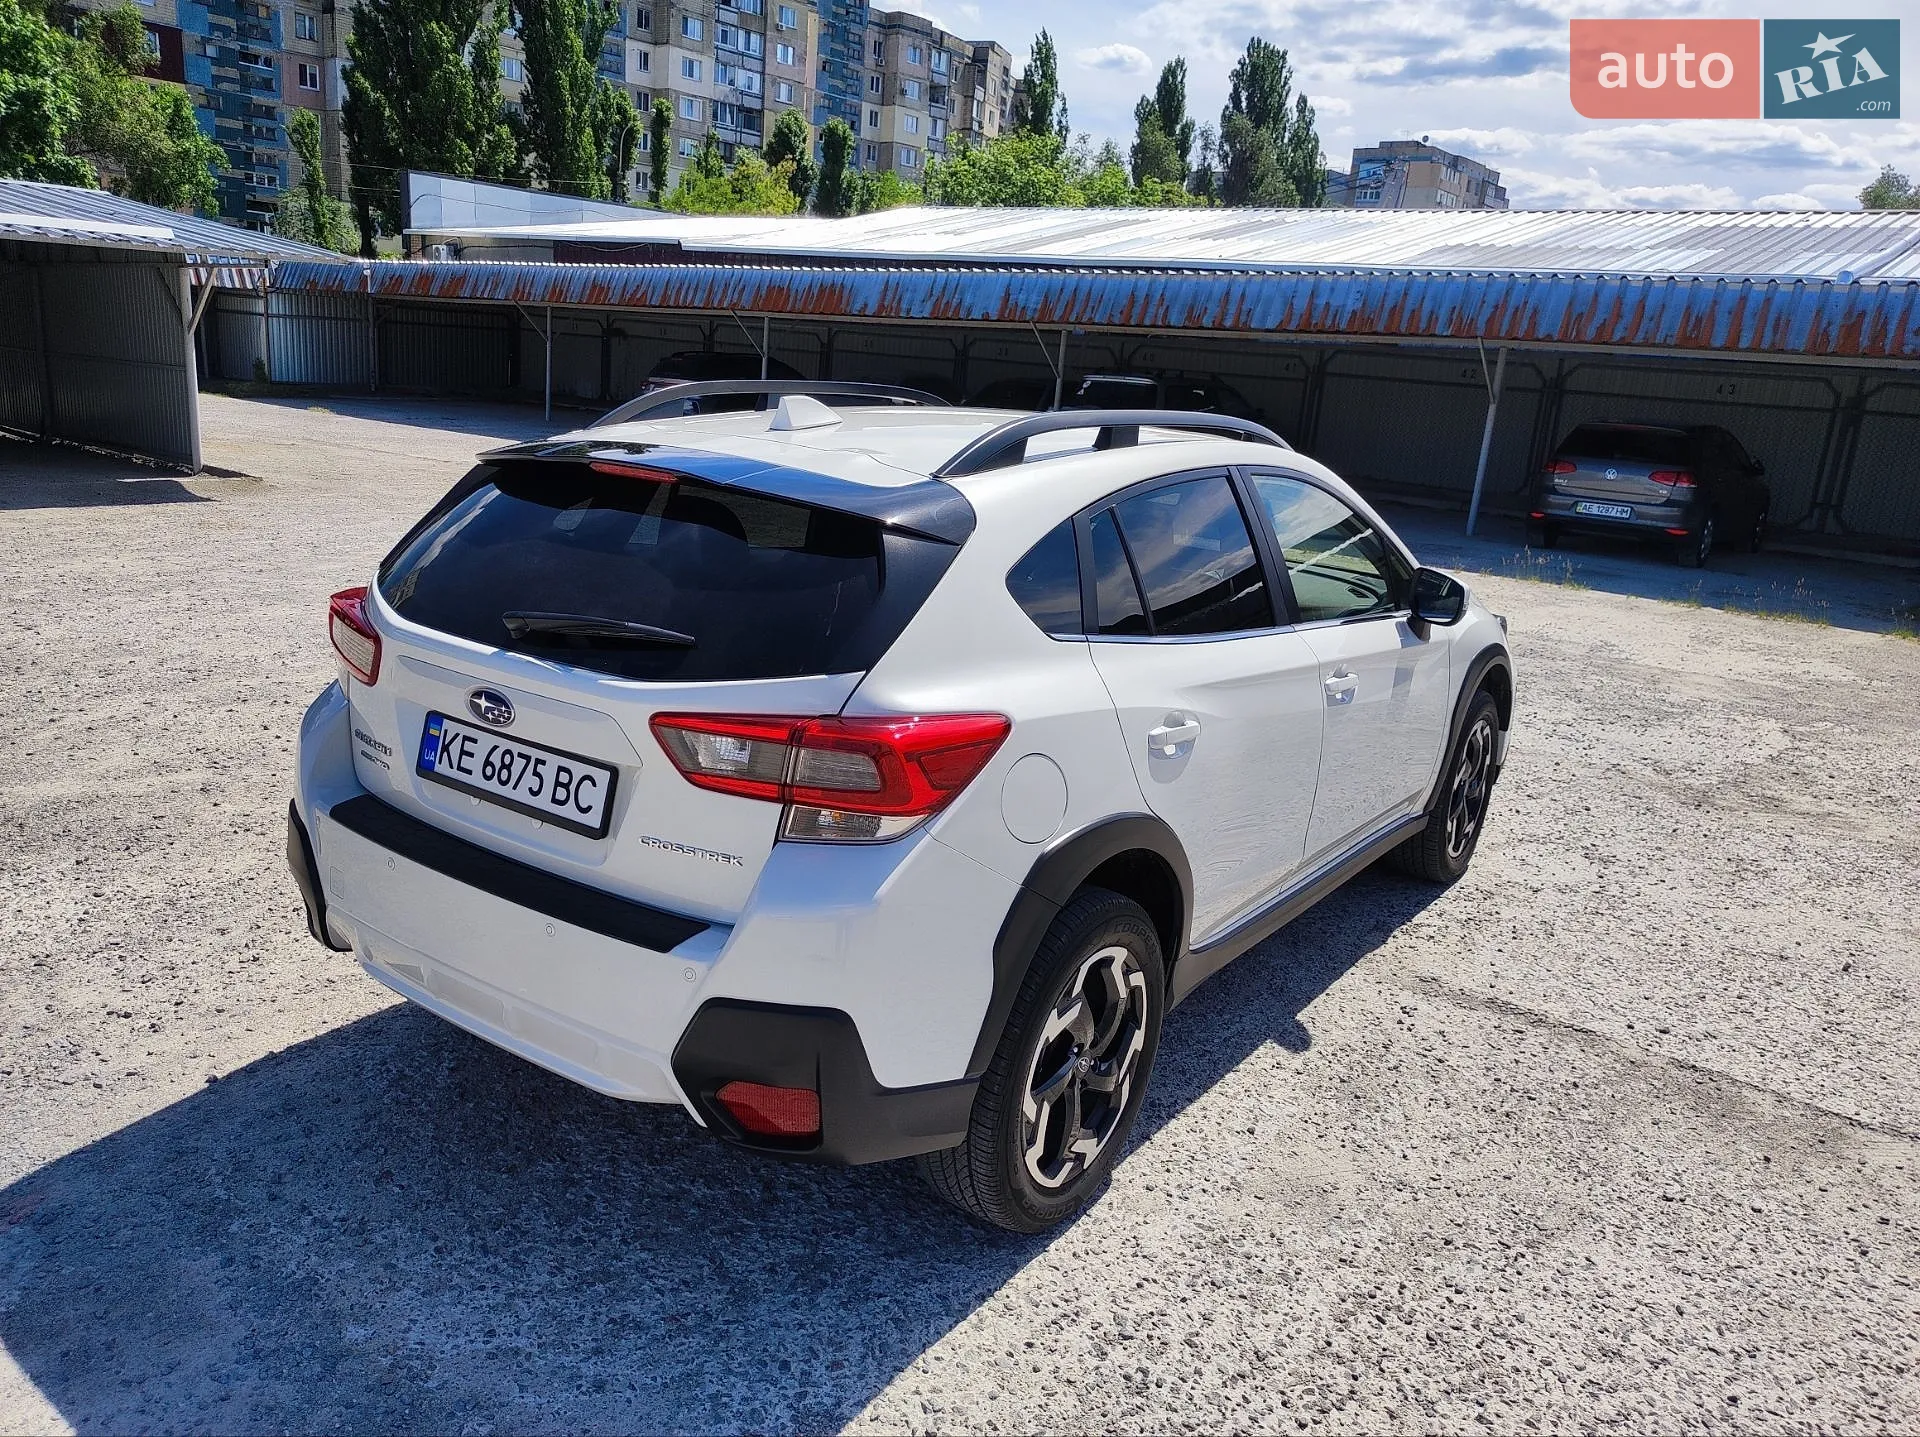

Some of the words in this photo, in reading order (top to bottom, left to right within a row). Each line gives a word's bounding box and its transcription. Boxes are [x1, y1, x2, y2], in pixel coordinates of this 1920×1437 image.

[1582, 503, 1593, 512] AE
[424, 749, 435, 762] UA
[438, 729, 478, 776] KE
[481, 744, 547, 798] 6875
[550, 765, 597, 815] BC
[639, 835, 743, 867] CROSSTREK
[1114, 921, 1156, 950] COOPE
